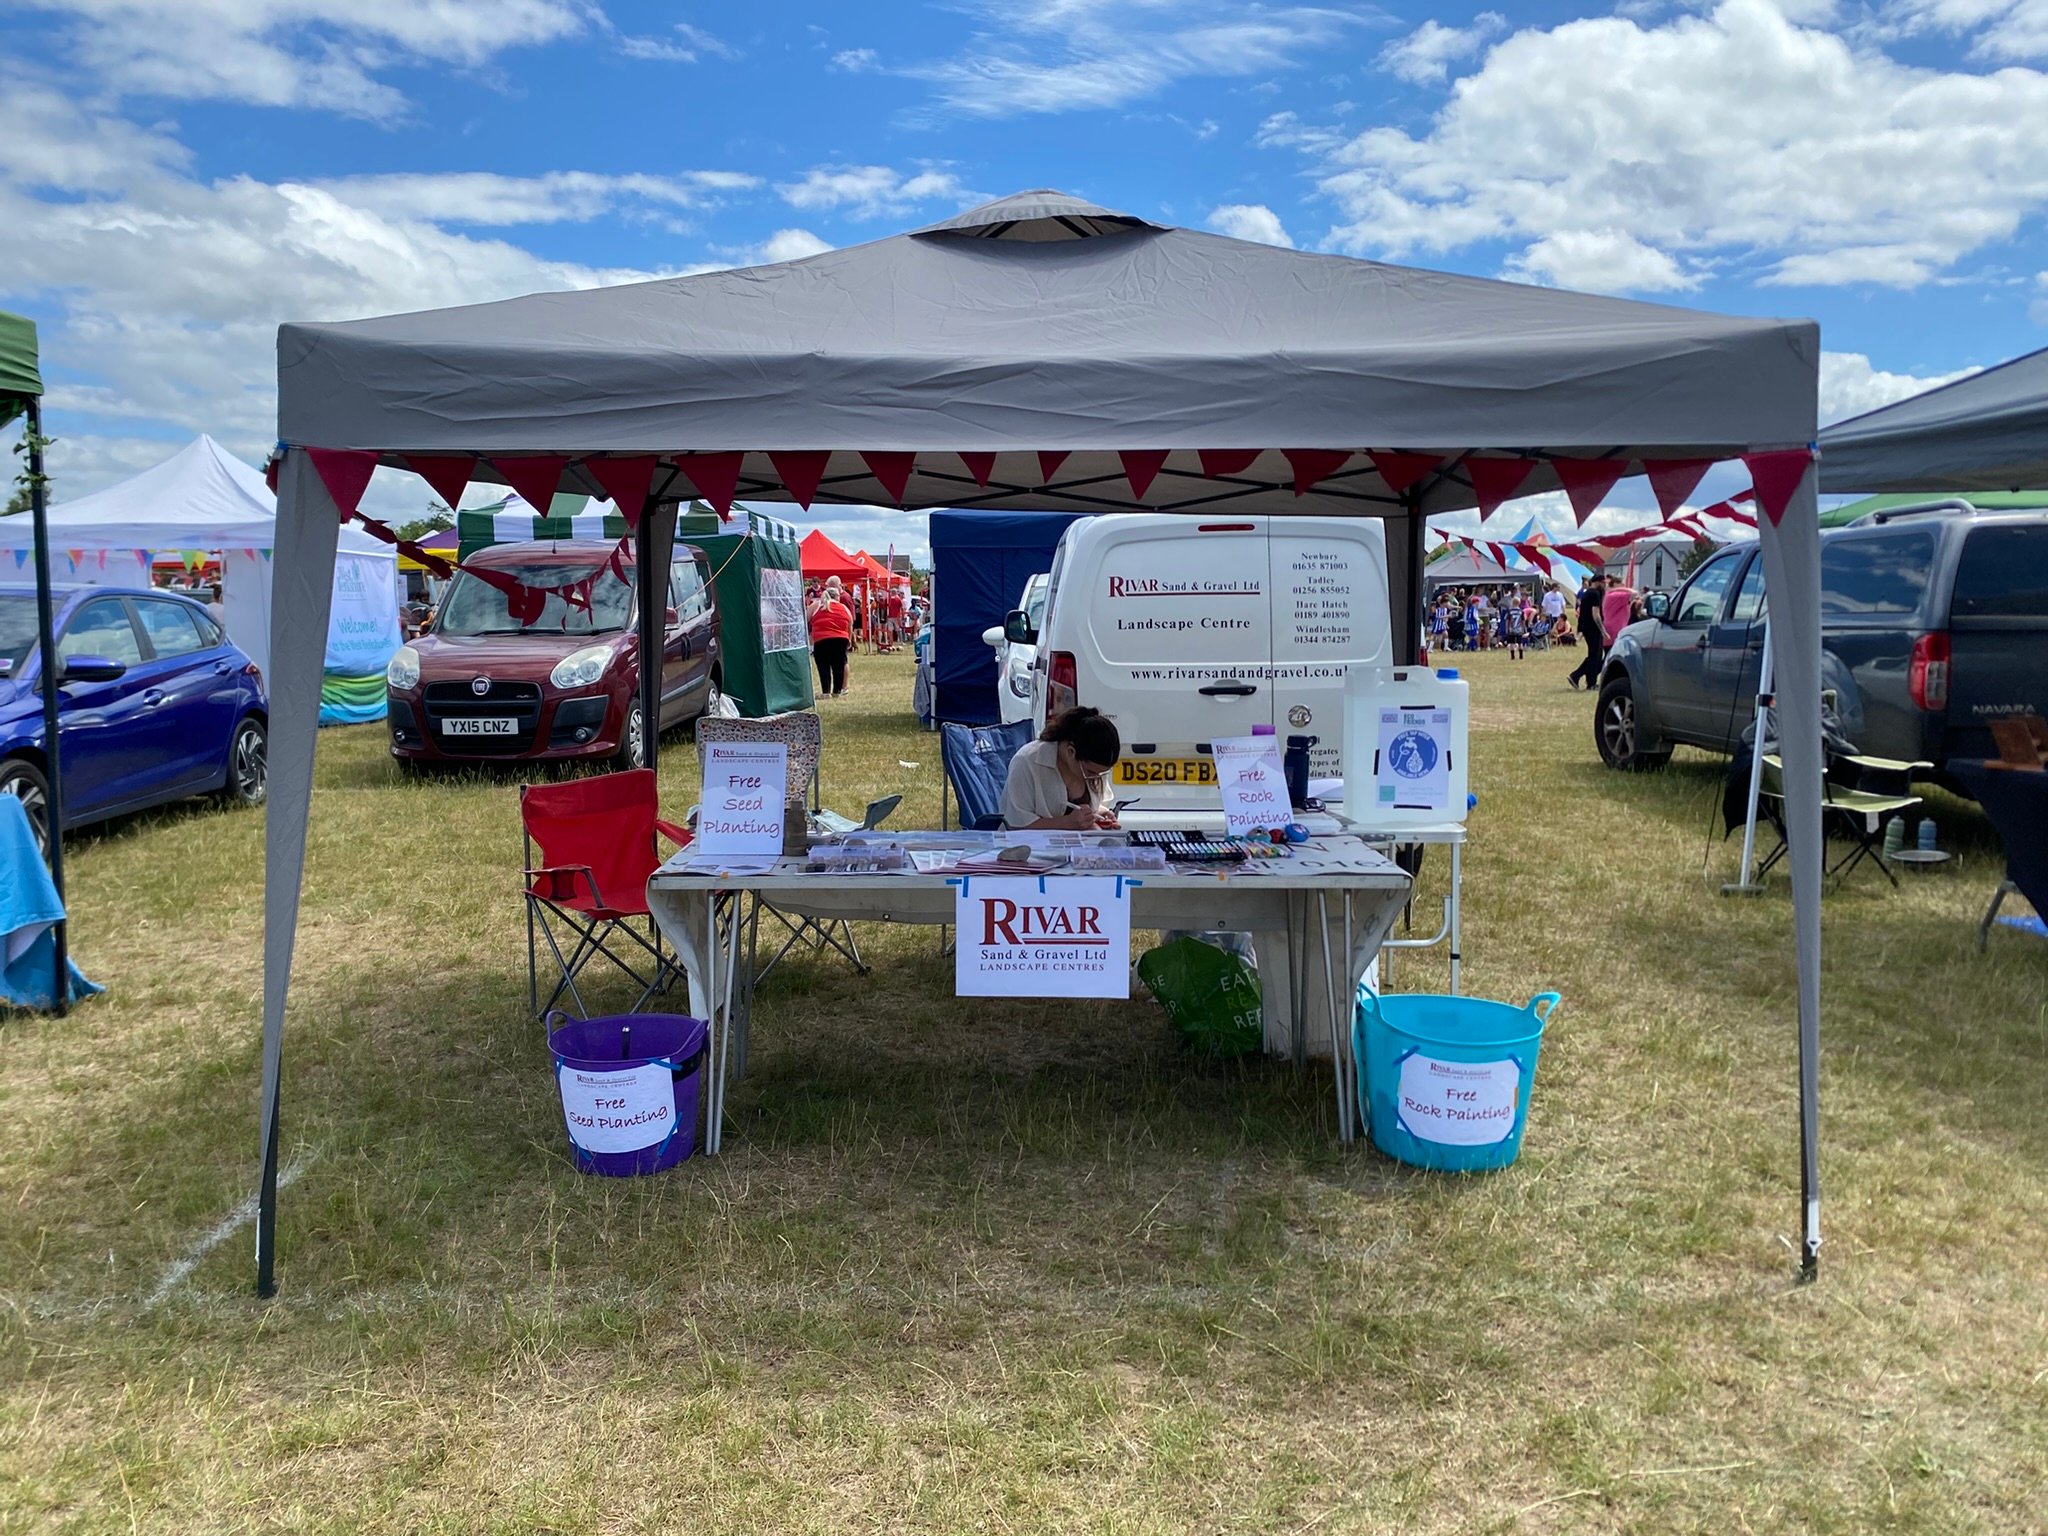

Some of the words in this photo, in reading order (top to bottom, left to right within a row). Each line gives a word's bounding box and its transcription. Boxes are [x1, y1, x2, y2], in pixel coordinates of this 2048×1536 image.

[1301, 552, 1338, 561] Newbury
[1292, 562, 1317, 570] 01635
[1320, 562, 1348, 570] 871003
[1162, 582, 1187, 591] Sand
[1191, 582, 1199, 591] &
[1204, 581, 1237, 591] Gravel
[1243, 581, 1260, 590] Ltd
[1307, 576, 1334, 585] Tadley
[1292, 586, 1317, 594] 01256
[1320, 586, 1350, 594] 855052
[1322, 600, 1349, 608] Hatch
[1294, 611, 1318, 619] 01189
[1321, 611, 1350, 619] 401890
[1117, 618, 1194, 631] Landscape
[1200, 617, 1251, 629] Centre
[1296, 625, 1350, 633] Windlesham
[1294, 636, 1318, 644] 01344
[1321, 636, 1351, 644] 874287
[1972, 704, 2036, 713] NAVARA
[450, 721, 480, 733] YX15
[483, 721, 510, 733] CNZ
[1122, 762, 1177, 781] DS20
[1239, 770, 1266, 782] Free
[729, 775, 762, 788] Free
[1238, 789, 1276, 803] Rock
[723, 796, 763, 811] Seed
[703, 819, 781, 839] Planting
[979, 898, 1102, 945] RIVAR
[981, 949, 1012, 960] Sand
[1018, 949, 1029, 960] &
[1035, 949, 1079, 960] Gravel
[1085, 949, 1107, 960] Ltd
[980, 963, 1048, 971] LANDSCAPE
[1053, 963, 1104, 971] CENTRES
[1446, 1088, 1477, 1101] Free
[595, 1098, 626, 1109] Free
[1404, 1097, 1442, 1119] Rock
[1446, 1105, 1510, 1120] Painting
[569, 1112, 595, 1128] Seed
[598, 1106, 668, 1129] Planting
